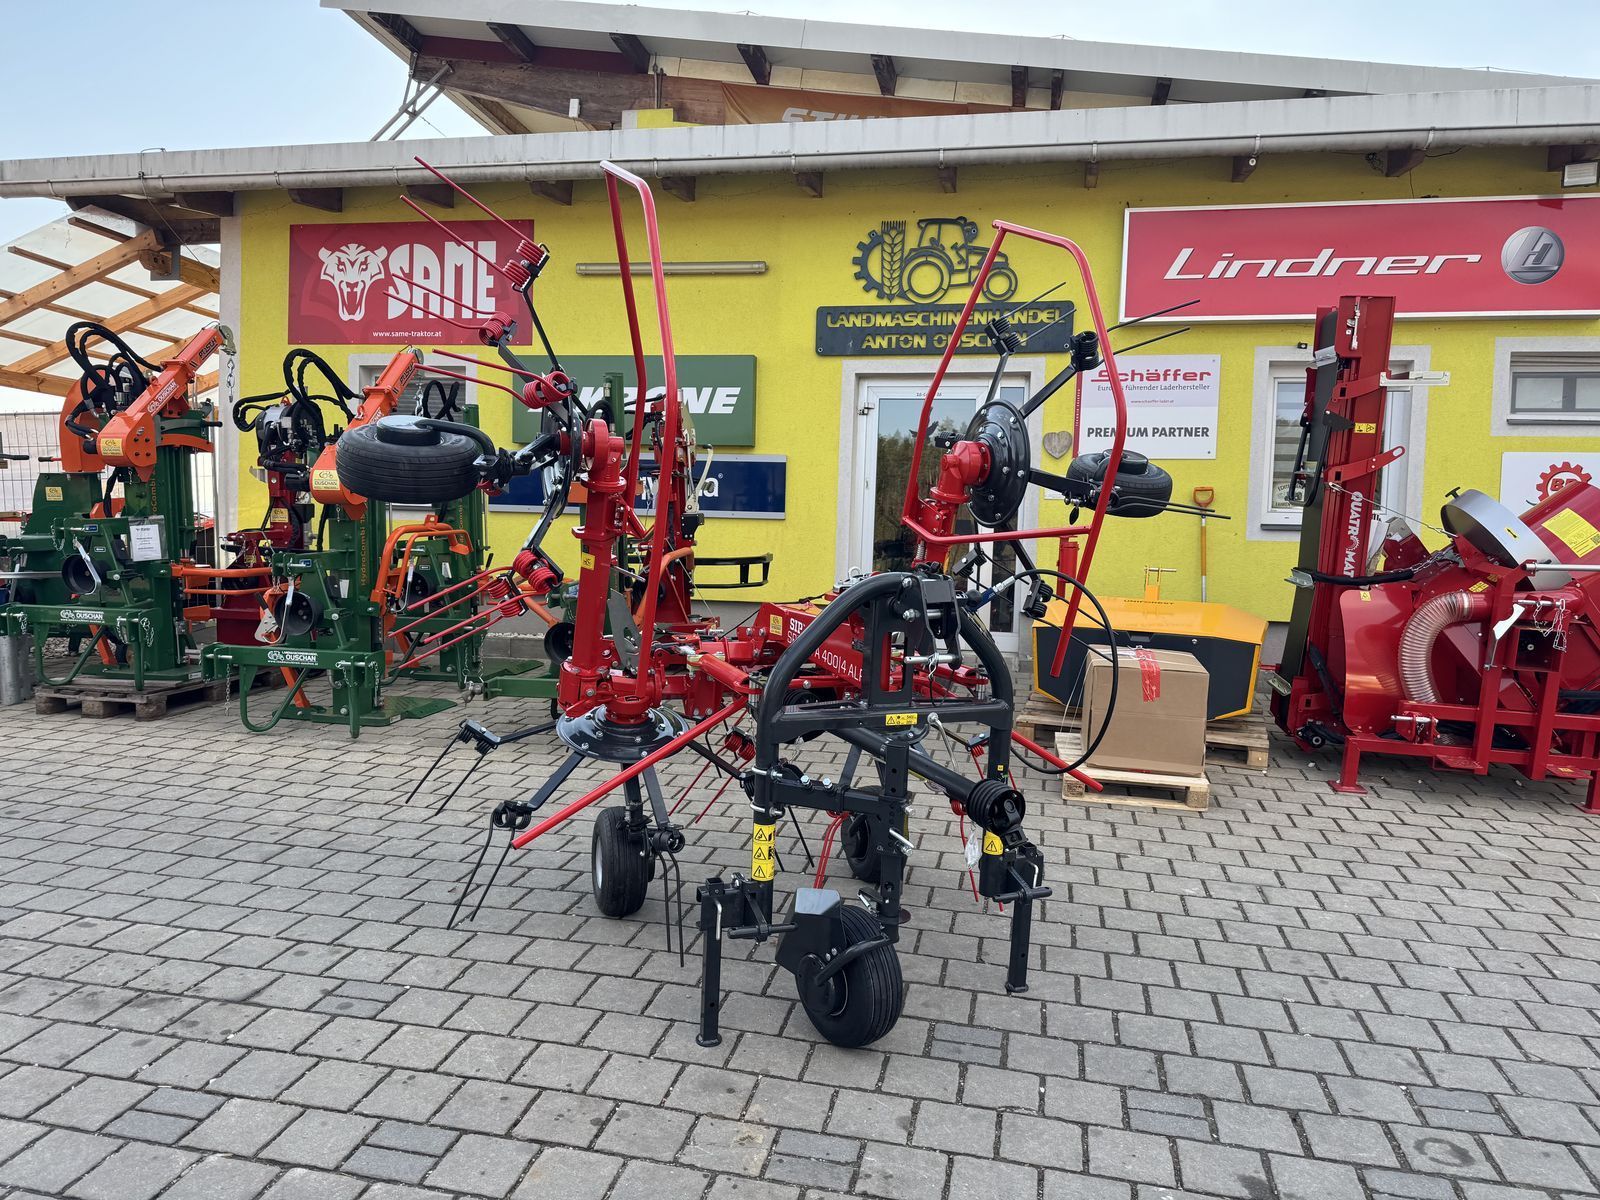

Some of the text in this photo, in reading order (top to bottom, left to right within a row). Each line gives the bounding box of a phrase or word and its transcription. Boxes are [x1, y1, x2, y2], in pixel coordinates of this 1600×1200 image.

[1163, 247, 1482, 279] Lindner
[388, 240, 497, 320] SAME
[372, 330, 442, 338] www.same-traktor.at
[861, 334, 927, 349] ANTON
[1151, 427, 1210, 437] PARTNER
[790, 617, 803, 635] SIP
